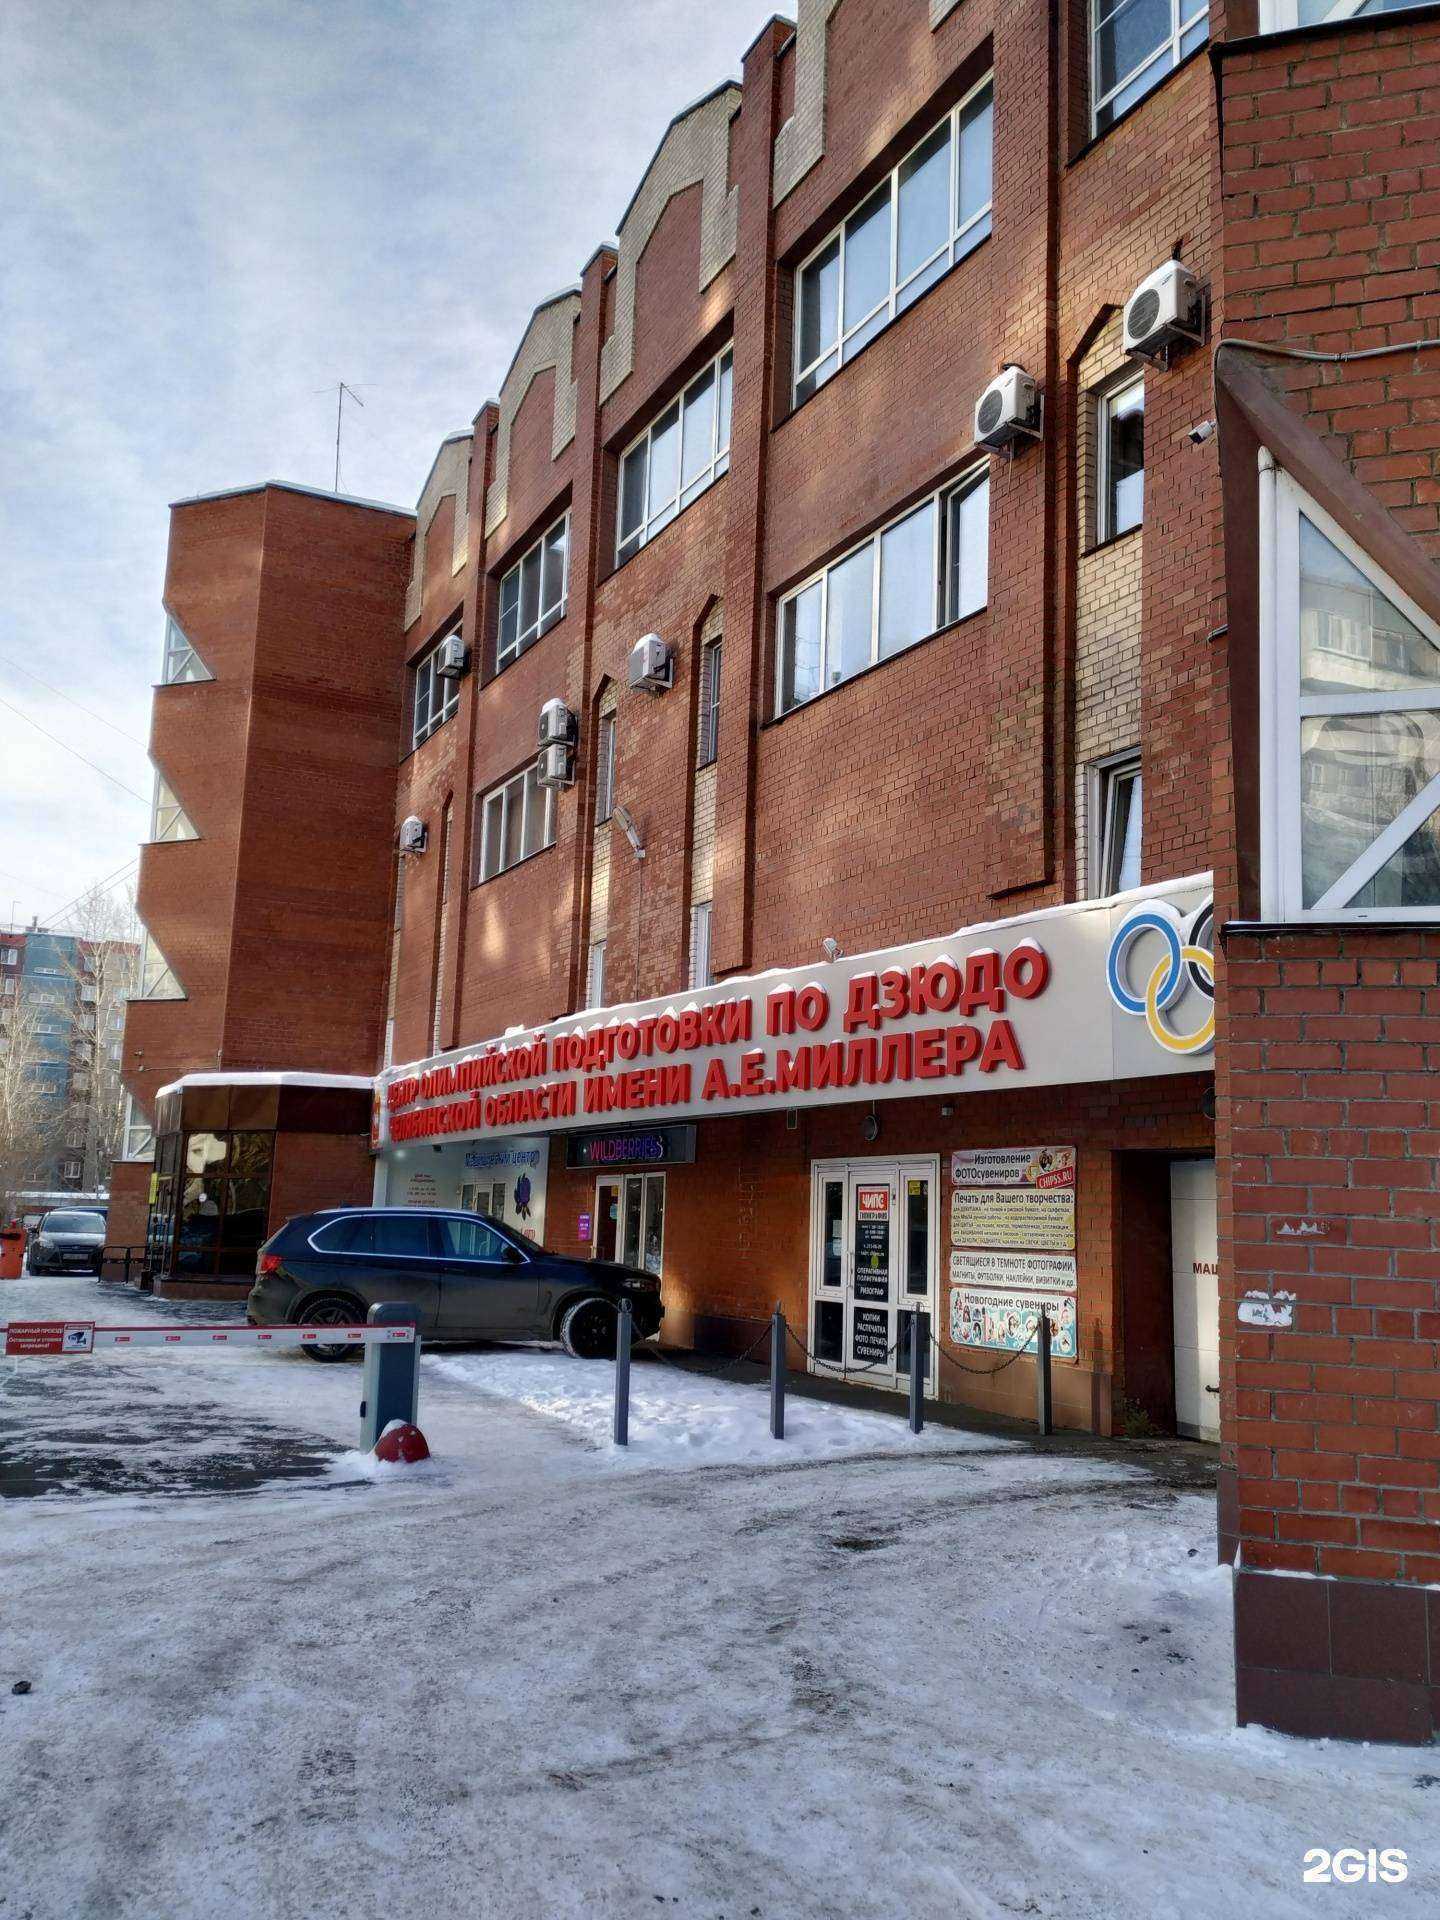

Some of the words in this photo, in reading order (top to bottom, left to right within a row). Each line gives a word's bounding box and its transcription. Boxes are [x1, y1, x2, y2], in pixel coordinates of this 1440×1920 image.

[420, 1032, 547, 1099] ОЛИМПИЙСКОЙ
[553, 999, 751, 1072] ПОДГОТОВКИ
[766, 985, 830, 1037] ПО
[843, 944, 1048, 1033] ДЗЮДО
[485, 1081, 577, 1127] ОБЛАСТИ
[583, 1063, 691, 1113] ИМЕНИ
[702, 1019, 1025, 1100] А.Е.МИЛЛЕРА
[590, 1136, 663, 1161] WILDBERRIES
[974, 1154, 1031, 1165] Изготовление
[955, 1168, 1020, 1182] ФОТОсувениров
[1039, 1169, 1073, 1188] CHIPSS.RU
[862, 1193, 885, 1209] ЧИПС
[955, 1193, 979, 1204] Печать
[981, 1194, 994, 1206] для
[996, 1192, 1024, 1204] Вашего
[1026, 1194, 1074, 1206] творчества:
[952, 1256, 990, 1267] СВЕТЯЩИЕСЯ
[991, 1258, 996, 1268] В
[996, 1258, 1026, 1270] ТЕМНОТЕ
[1026, 1258, 1074, 1273] ФОТОГРАФИИ,
[977, 1271, 1005, 1282] ФУТБОЛКИ,
[1006, 1272, 1035, 1284] НАКЛЕЙКИ,
[1036, 1275, 1060, 1284] ВИЗИТКИ
[964, 1293, 1014, 1309] Новогодние
[1016, 1297, 1060, 1312] сувениры
[862, 1313, 880, 1322] КОПИИ
[856, 1322, 886, 1334] РАСПЕЧАТКА
[855, 1334, 869, 1342] ФОТО
[856, 1346, 884, 1358] СУВЕНИРЫ
